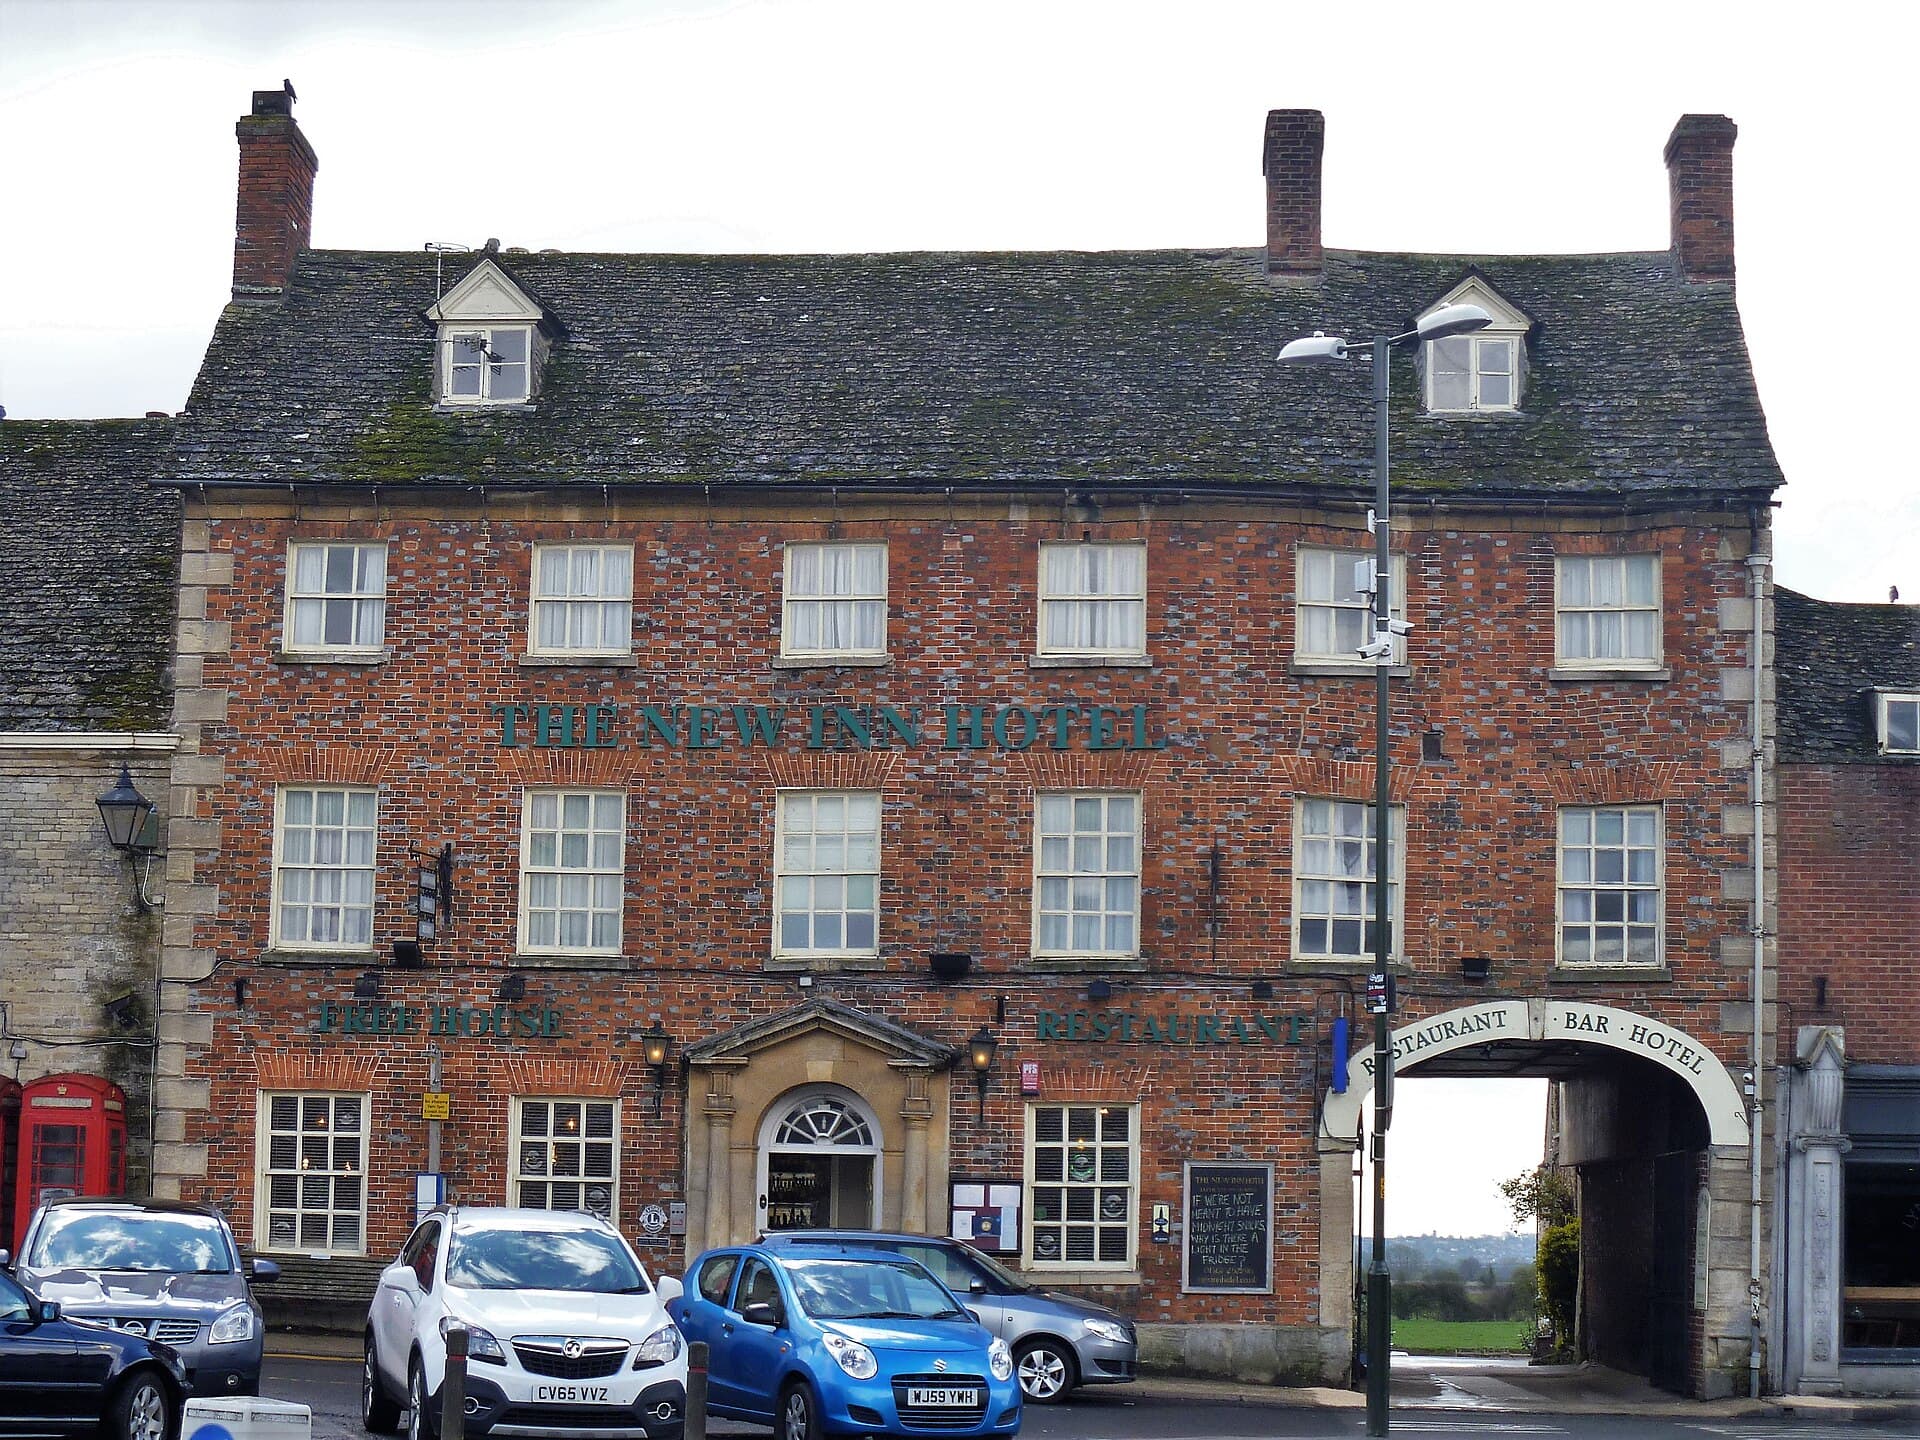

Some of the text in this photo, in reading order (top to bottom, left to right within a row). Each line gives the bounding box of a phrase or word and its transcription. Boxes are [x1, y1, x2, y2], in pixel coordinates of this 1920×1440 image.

[493, 704, 1167, 750] THE NEW INN HOTEL
[319, 1002, 566, 1038] FREE HOUSE
[1036, 1009, 1310, 1045] RESTAURANT
[1361, 1010, 1705, 1077] RSTAURANT BAR HOTEL
[1192, 1194, 1201, 1206] IF
[1233, 1193, 1254, 1205] NOT
[1192, 1204, 1264, 1220] MEANT TO HAVE
[1192, 1221, 1235, 1233] MIDNIGHT
[1191, 1232, 1259, 1243] WHY IS THERE A
[1191, 1244, 1249, 1254] LIGHT IN THE
[538, 1386, 608, 1401] CV65 VVZ
[913, 1390, 973, 1404] WJ59 YWH
